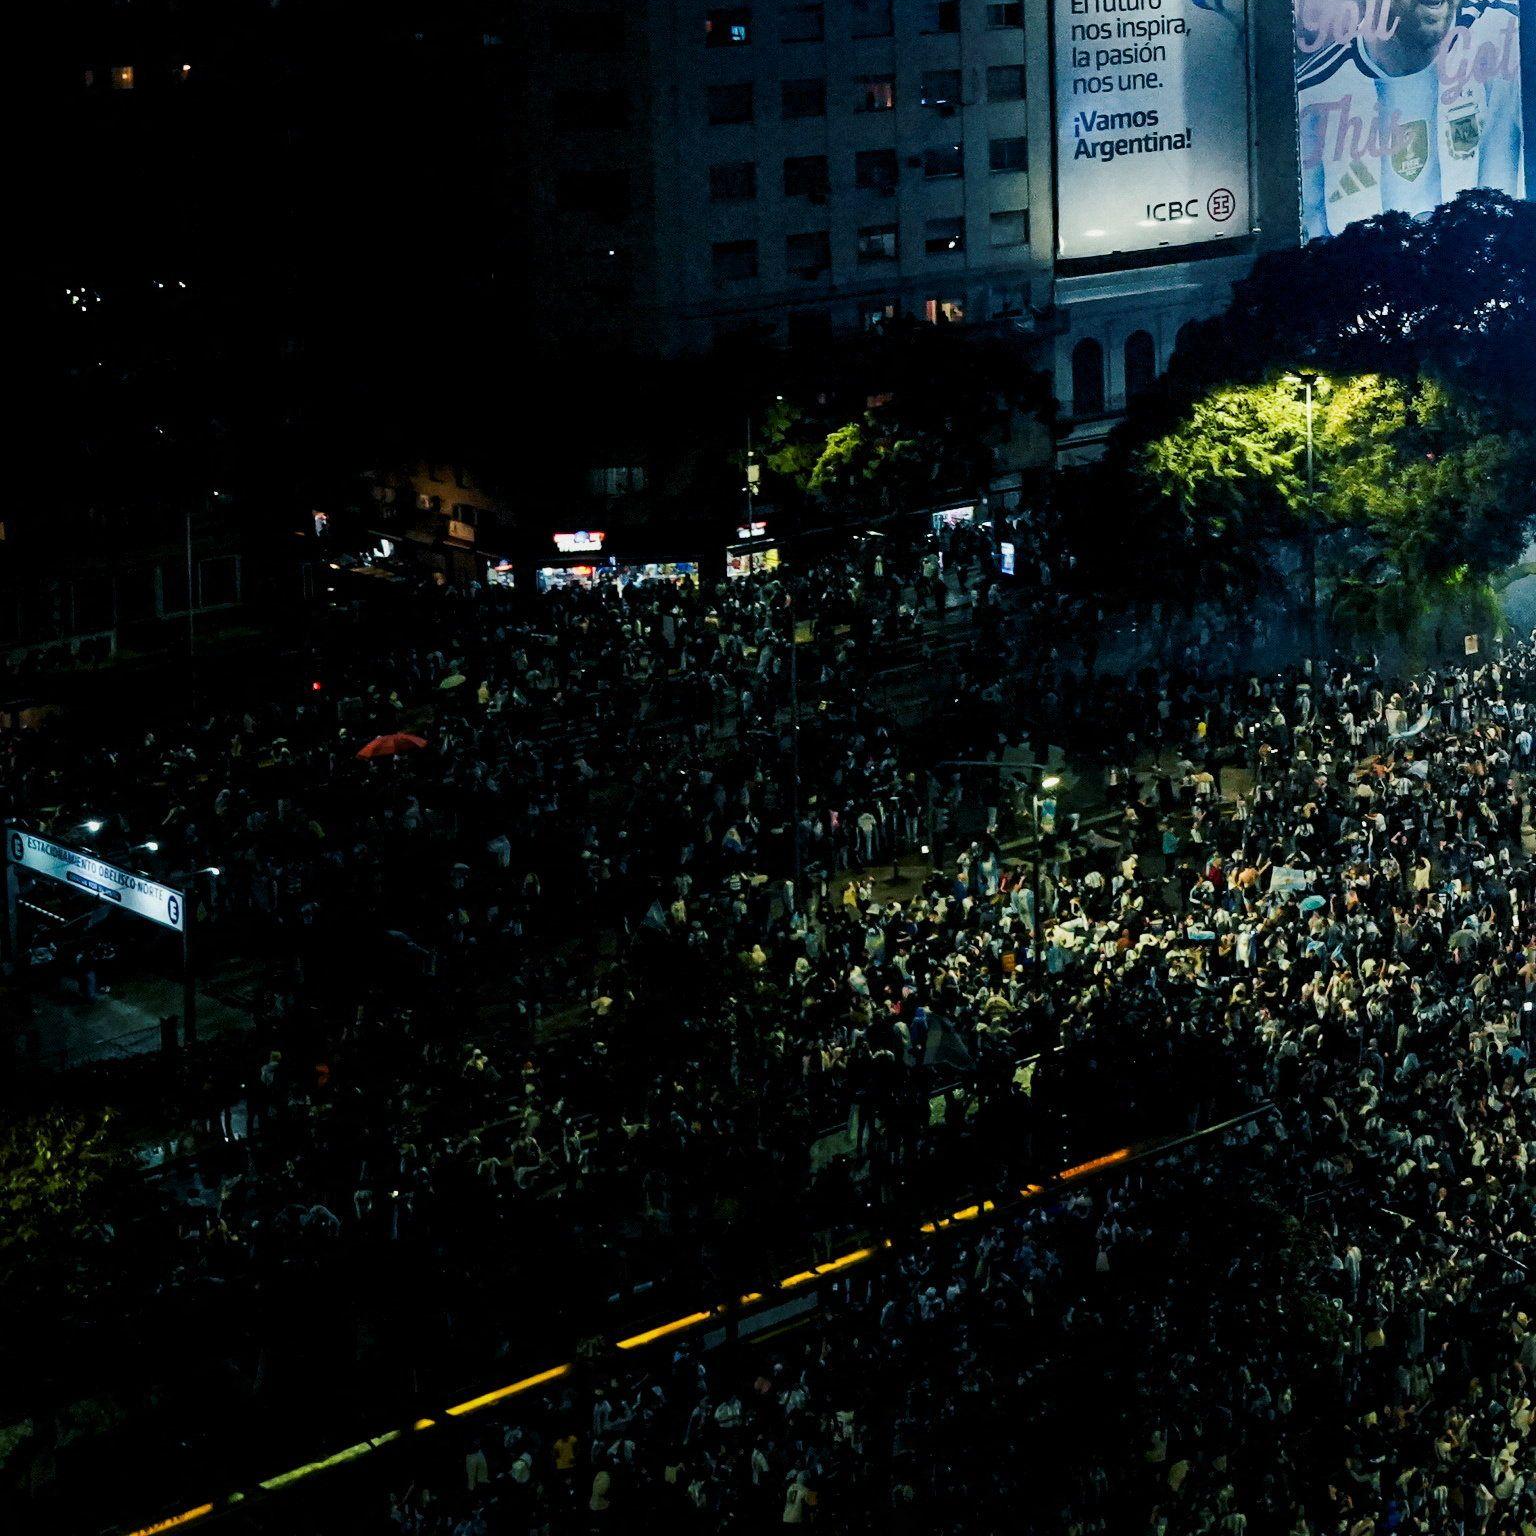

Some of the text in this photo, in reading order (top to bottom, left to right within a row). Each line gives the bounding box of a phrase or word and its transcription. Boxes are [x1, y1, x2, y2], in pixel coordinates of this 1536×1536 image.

[1072, 14, 1191, 44] nos inspira,
[1072, 41, 1166, 71] la pasión
[1437, 16, 1518, 105] Got
[1073, 71, 1163, 96] nos une.
[1074, 108, 1159, 138] ¡Vamos
[1300, 94, 1403, 170] This
[1074, 128, 1192, 162] Argentina!
[1146, 199, 1199, 223] ICBC
[27, 836, 97, 874] ESTACIONAMIENTO
[99, 864, 136, 890] OBELISCO
[137, 880, 165, 902] NORTE
